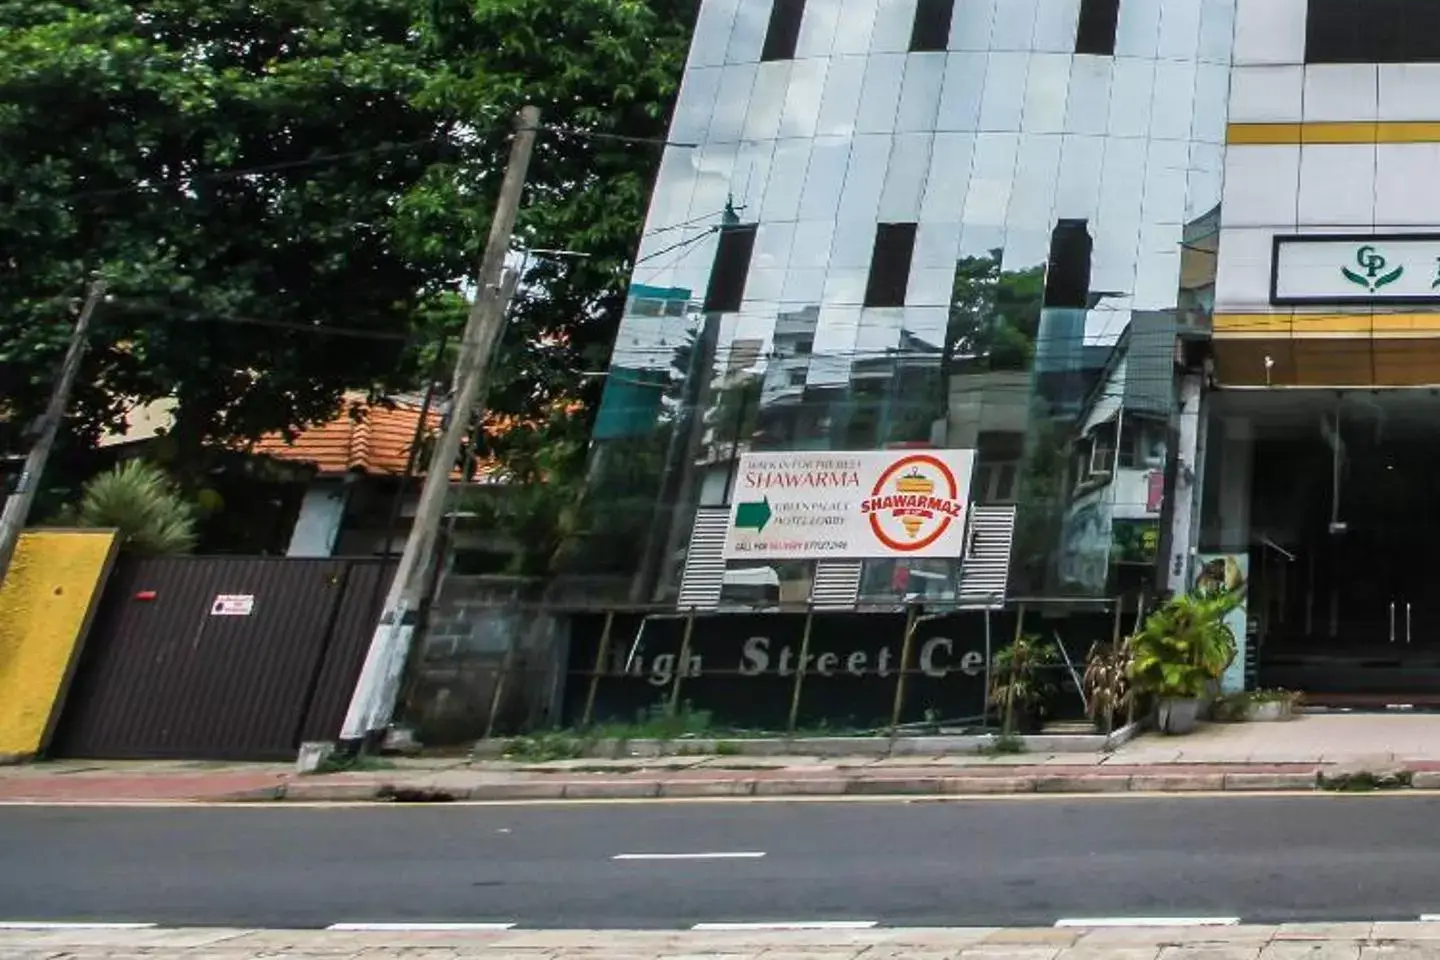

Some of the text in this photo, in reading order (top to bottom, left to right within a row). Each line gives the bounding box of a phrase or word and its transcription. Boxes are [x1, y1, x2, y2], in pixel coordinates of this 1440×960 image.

[744, 470, 860, 489] SHAWARMA
[861, 494, 962, 518] SHAWARMAZ
[739, 636, 893, 678] Street
